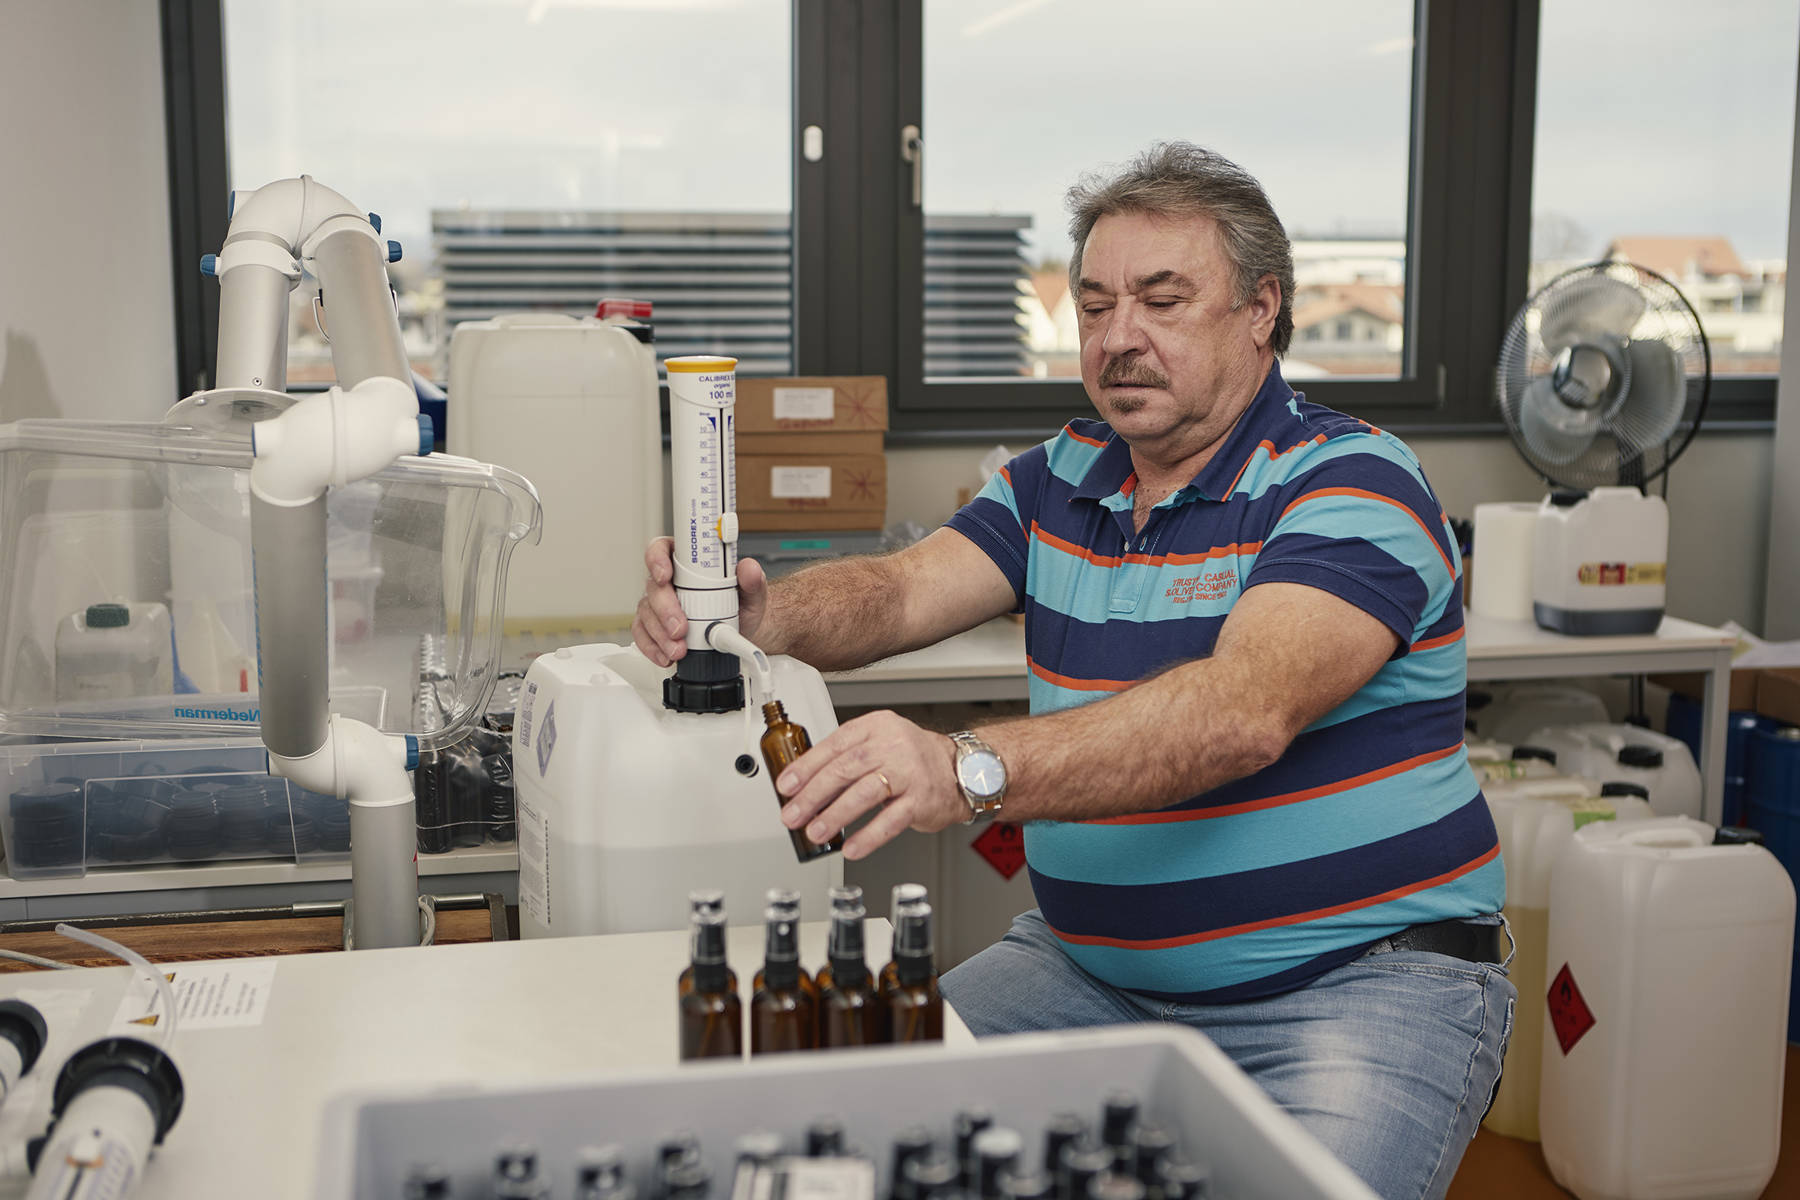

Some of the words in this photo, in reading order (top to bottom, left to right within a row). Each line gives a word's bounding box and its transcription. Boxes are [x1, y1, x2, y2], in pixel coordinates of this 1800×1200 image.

[709, 390, 724, 399] 100
[690, 518, 698, 564] SOCOREX
[1204, 569, 1236, 582] CASUAL
[1165, 586, 1195, 597] S.OLIVE
[1195, 578, 1238, 592] COMPANY
